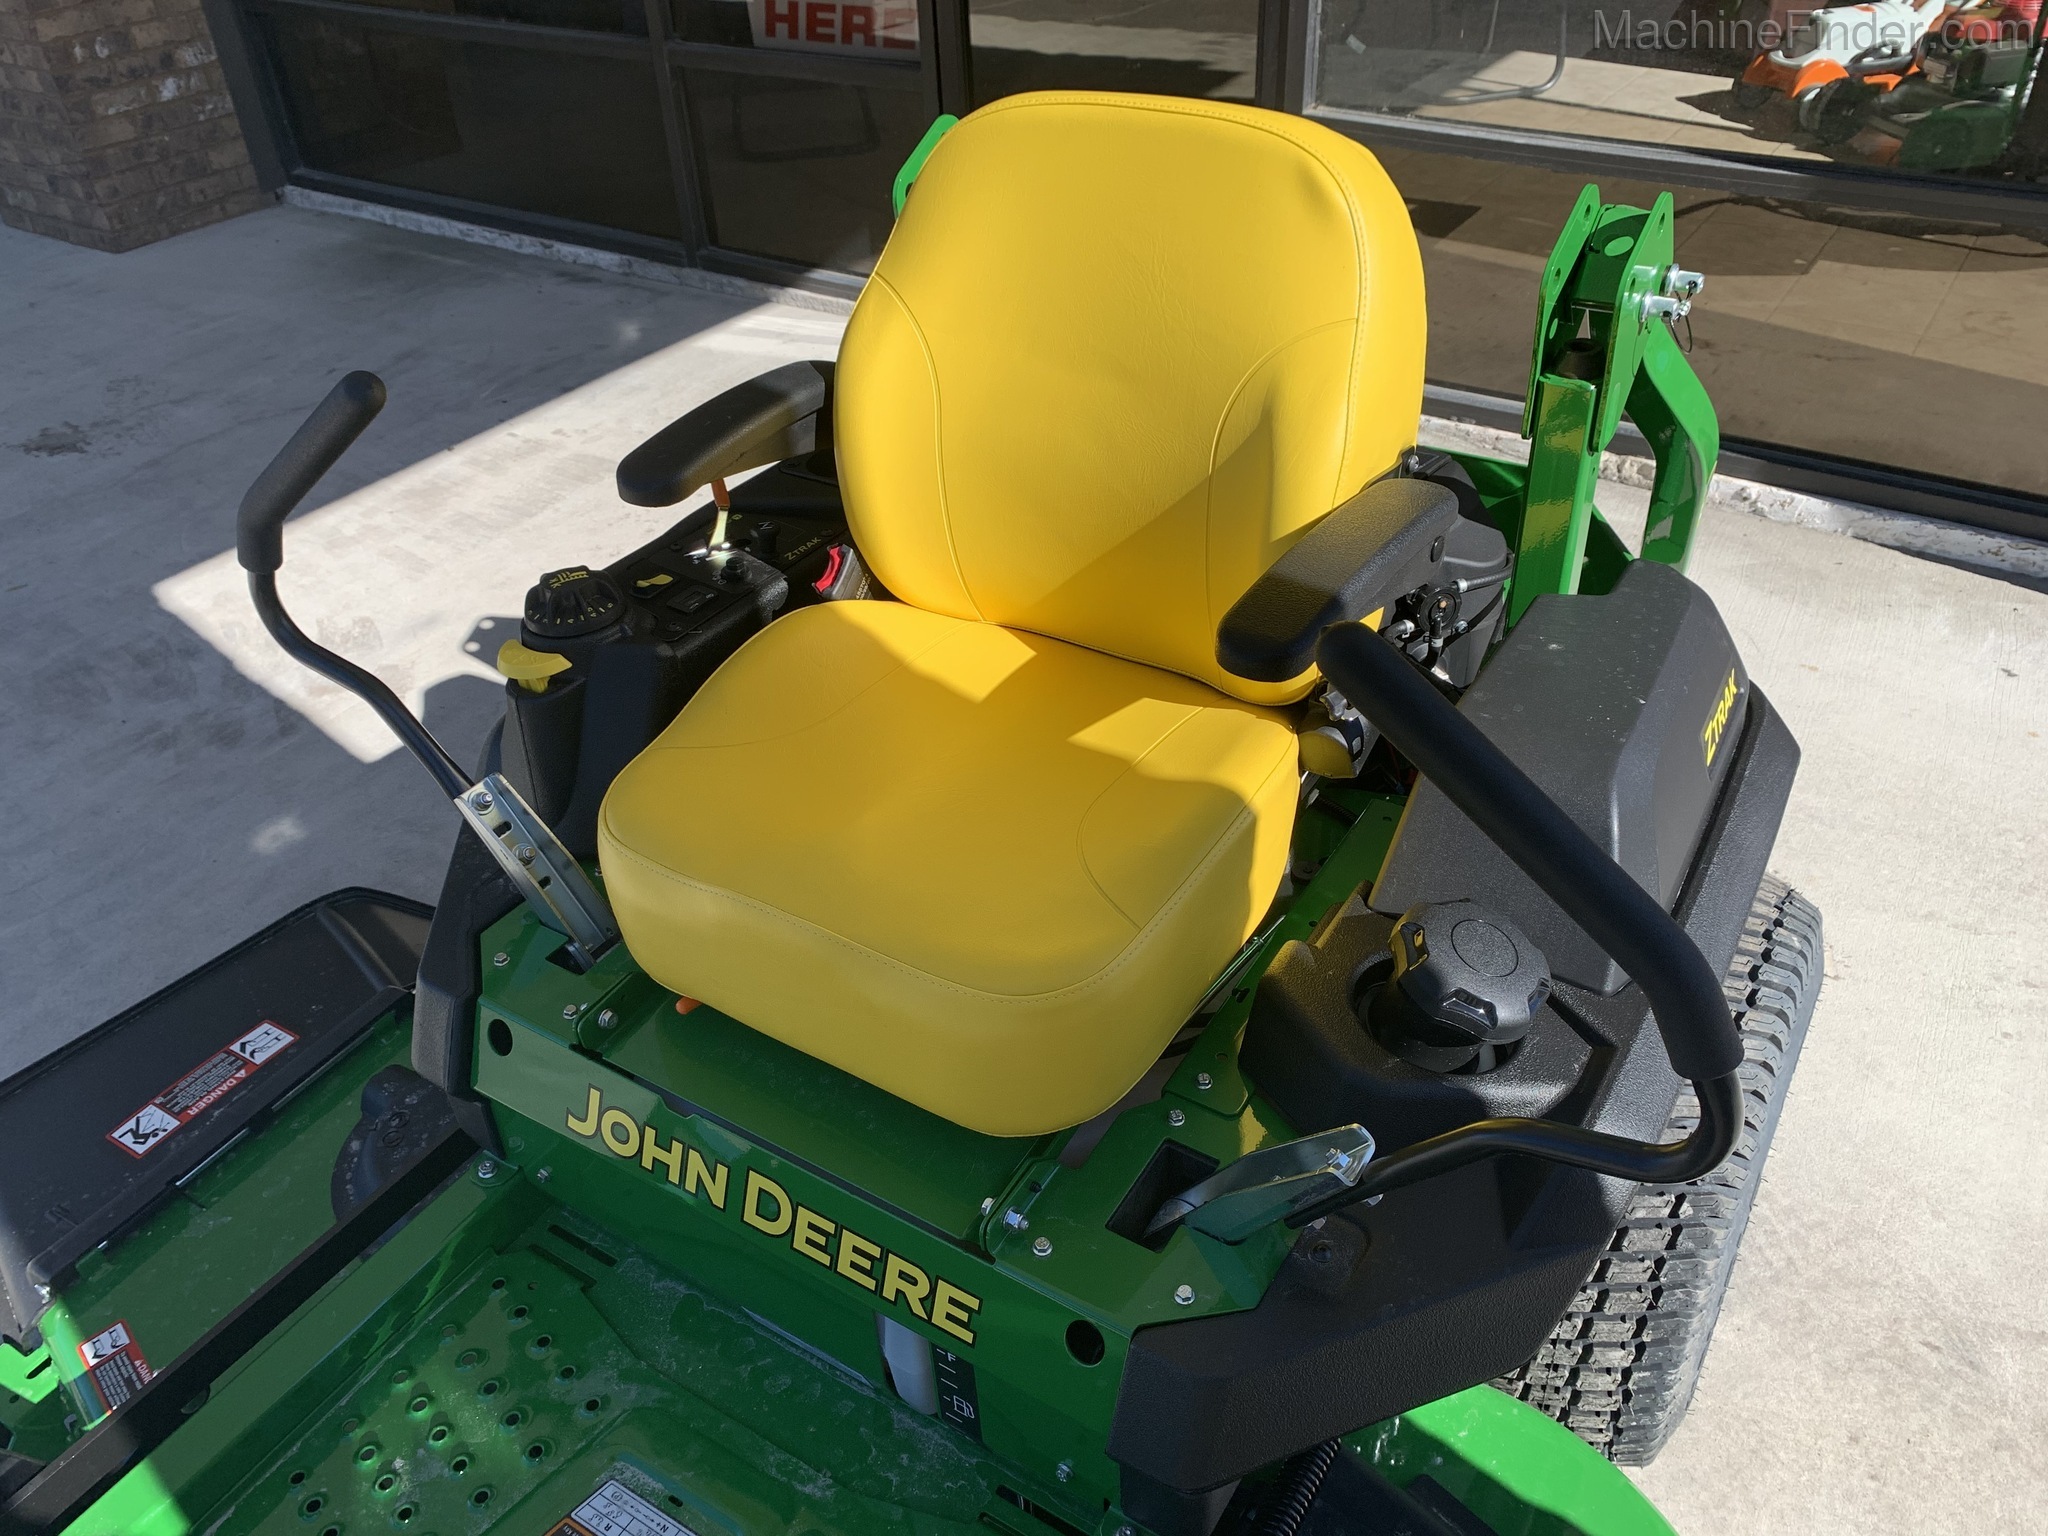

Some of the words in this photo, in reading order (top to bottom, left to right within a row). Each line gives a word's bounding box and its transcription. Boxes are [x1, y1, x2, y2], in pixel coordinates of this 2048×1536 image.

[784, 536, 822, 561] ZTRAK
[1704, 667, 1738, 767] ZTRAK
[187, 1077, 237, 1115] DANGER
[566, 1083, 730, 1212] JOHN
[741, 1167, 982, 1348] DEERE
